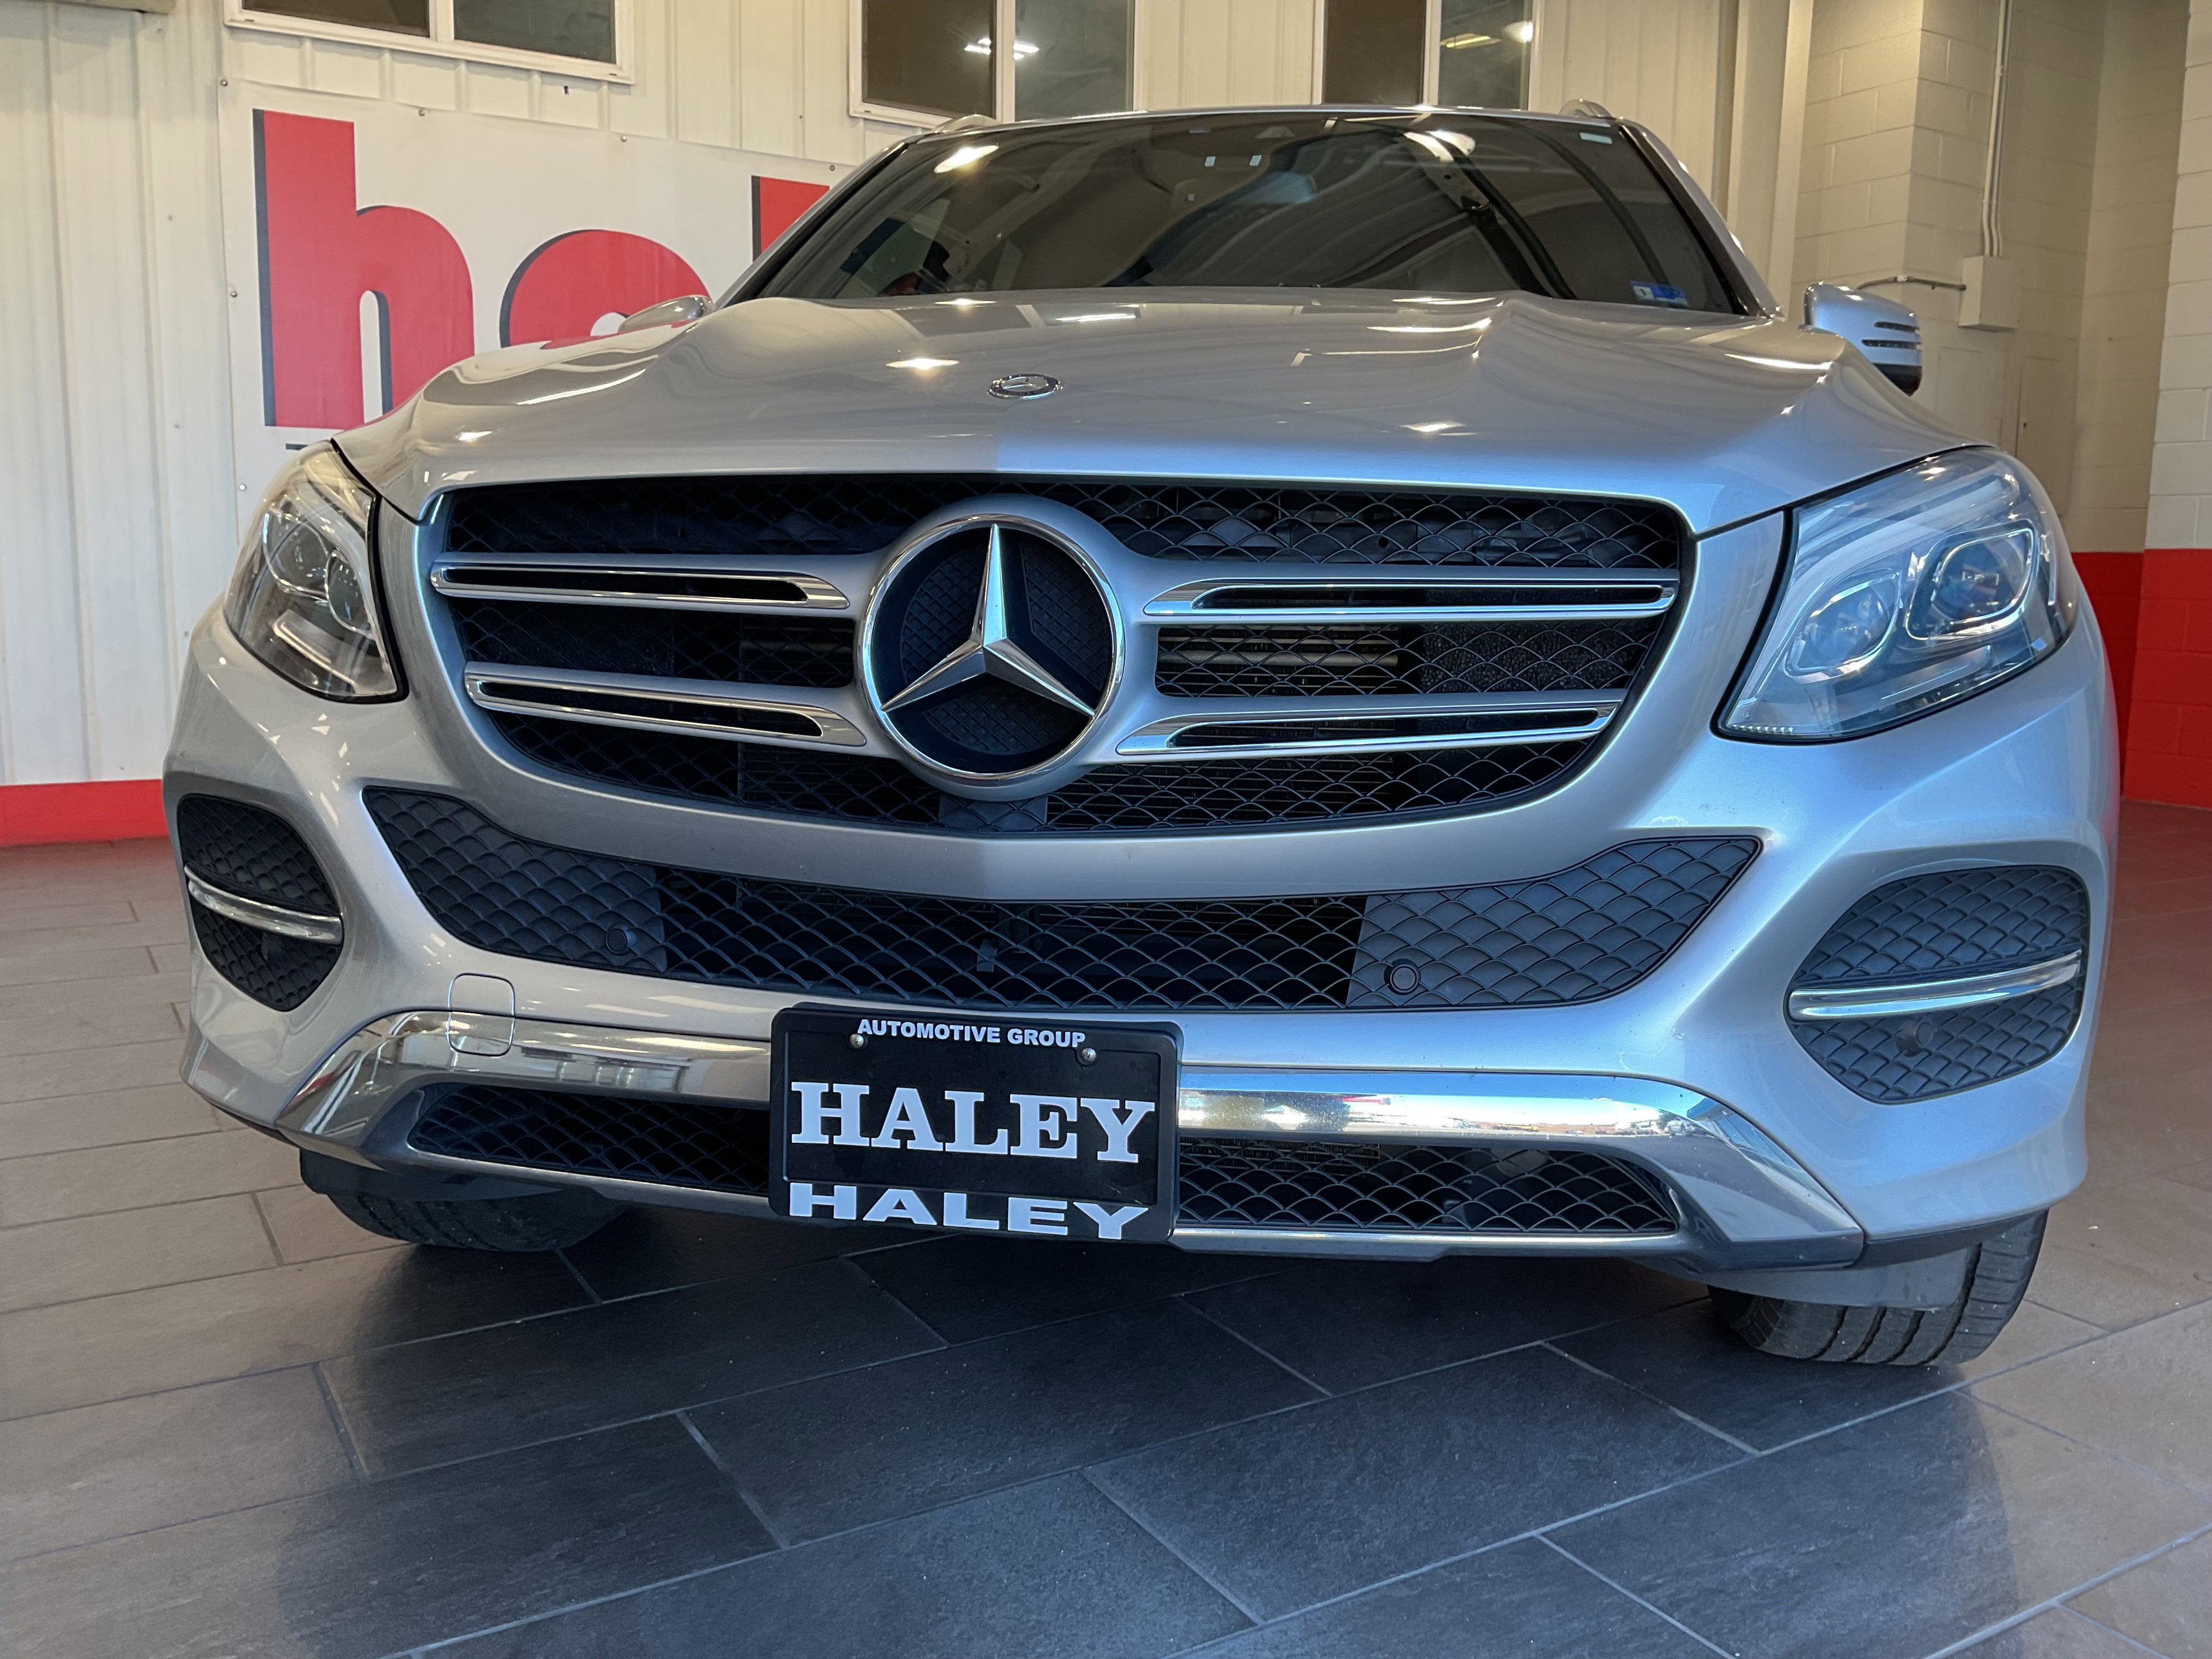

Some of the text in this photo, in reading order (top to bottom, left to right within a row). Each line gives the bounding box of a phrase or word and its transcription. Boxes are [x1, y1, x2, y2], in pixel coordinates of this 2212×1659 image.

[857, 1019, 1086, 1048] AUTOMOTIVE GROUP
[791, 1081, 1155, 1163] HALEY
[789, 1182, 1148, 1240] HALEY
